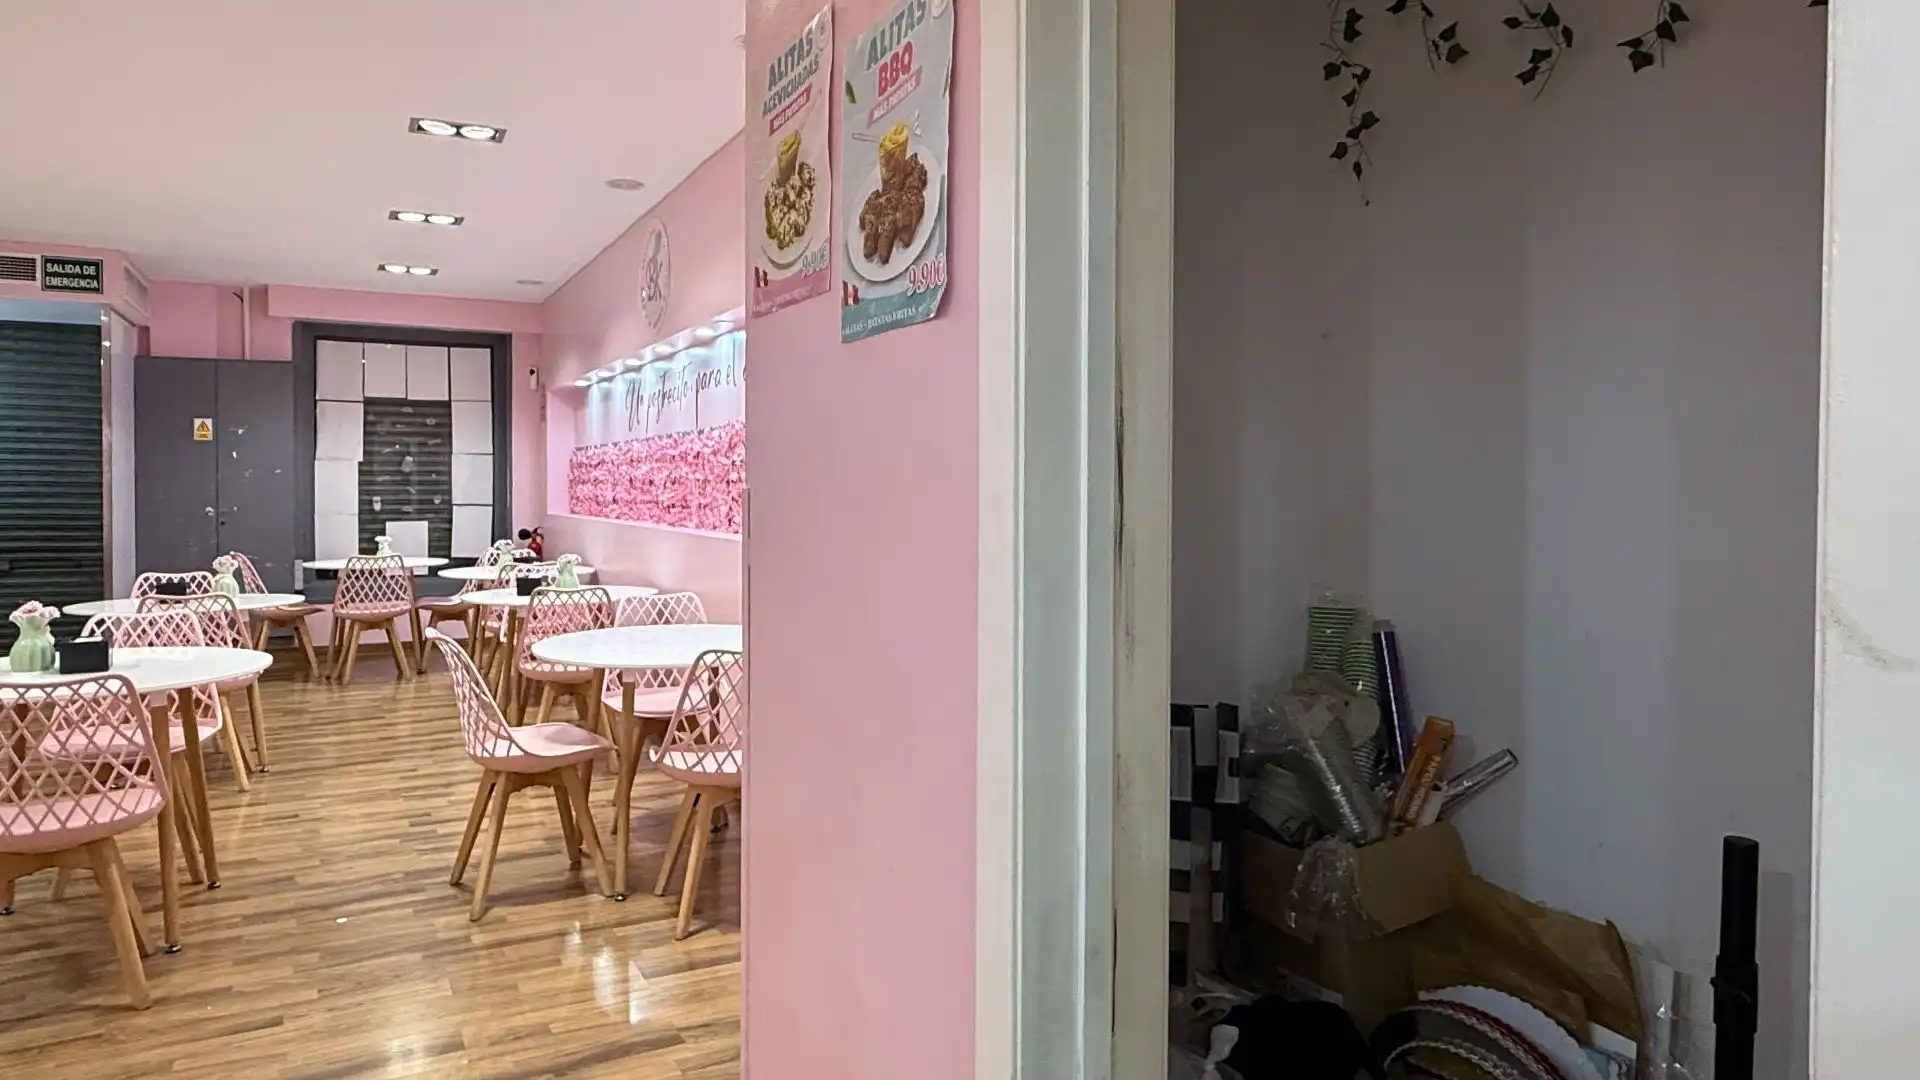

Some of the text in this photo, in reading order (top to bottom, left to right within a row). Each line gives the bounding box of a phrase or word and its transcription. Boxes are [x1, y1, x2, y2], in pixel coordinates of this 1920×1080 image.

[768, 29, 813, 91] ALITAS
[866, 0, 926, 72] ALITAS
[878, 40, 913, 97] BBQ
[45, 276, 99, 289] EMERGENCIA
[46, 262, 97, 276] SALIDA DE
[695, 368, 722, 429] para
